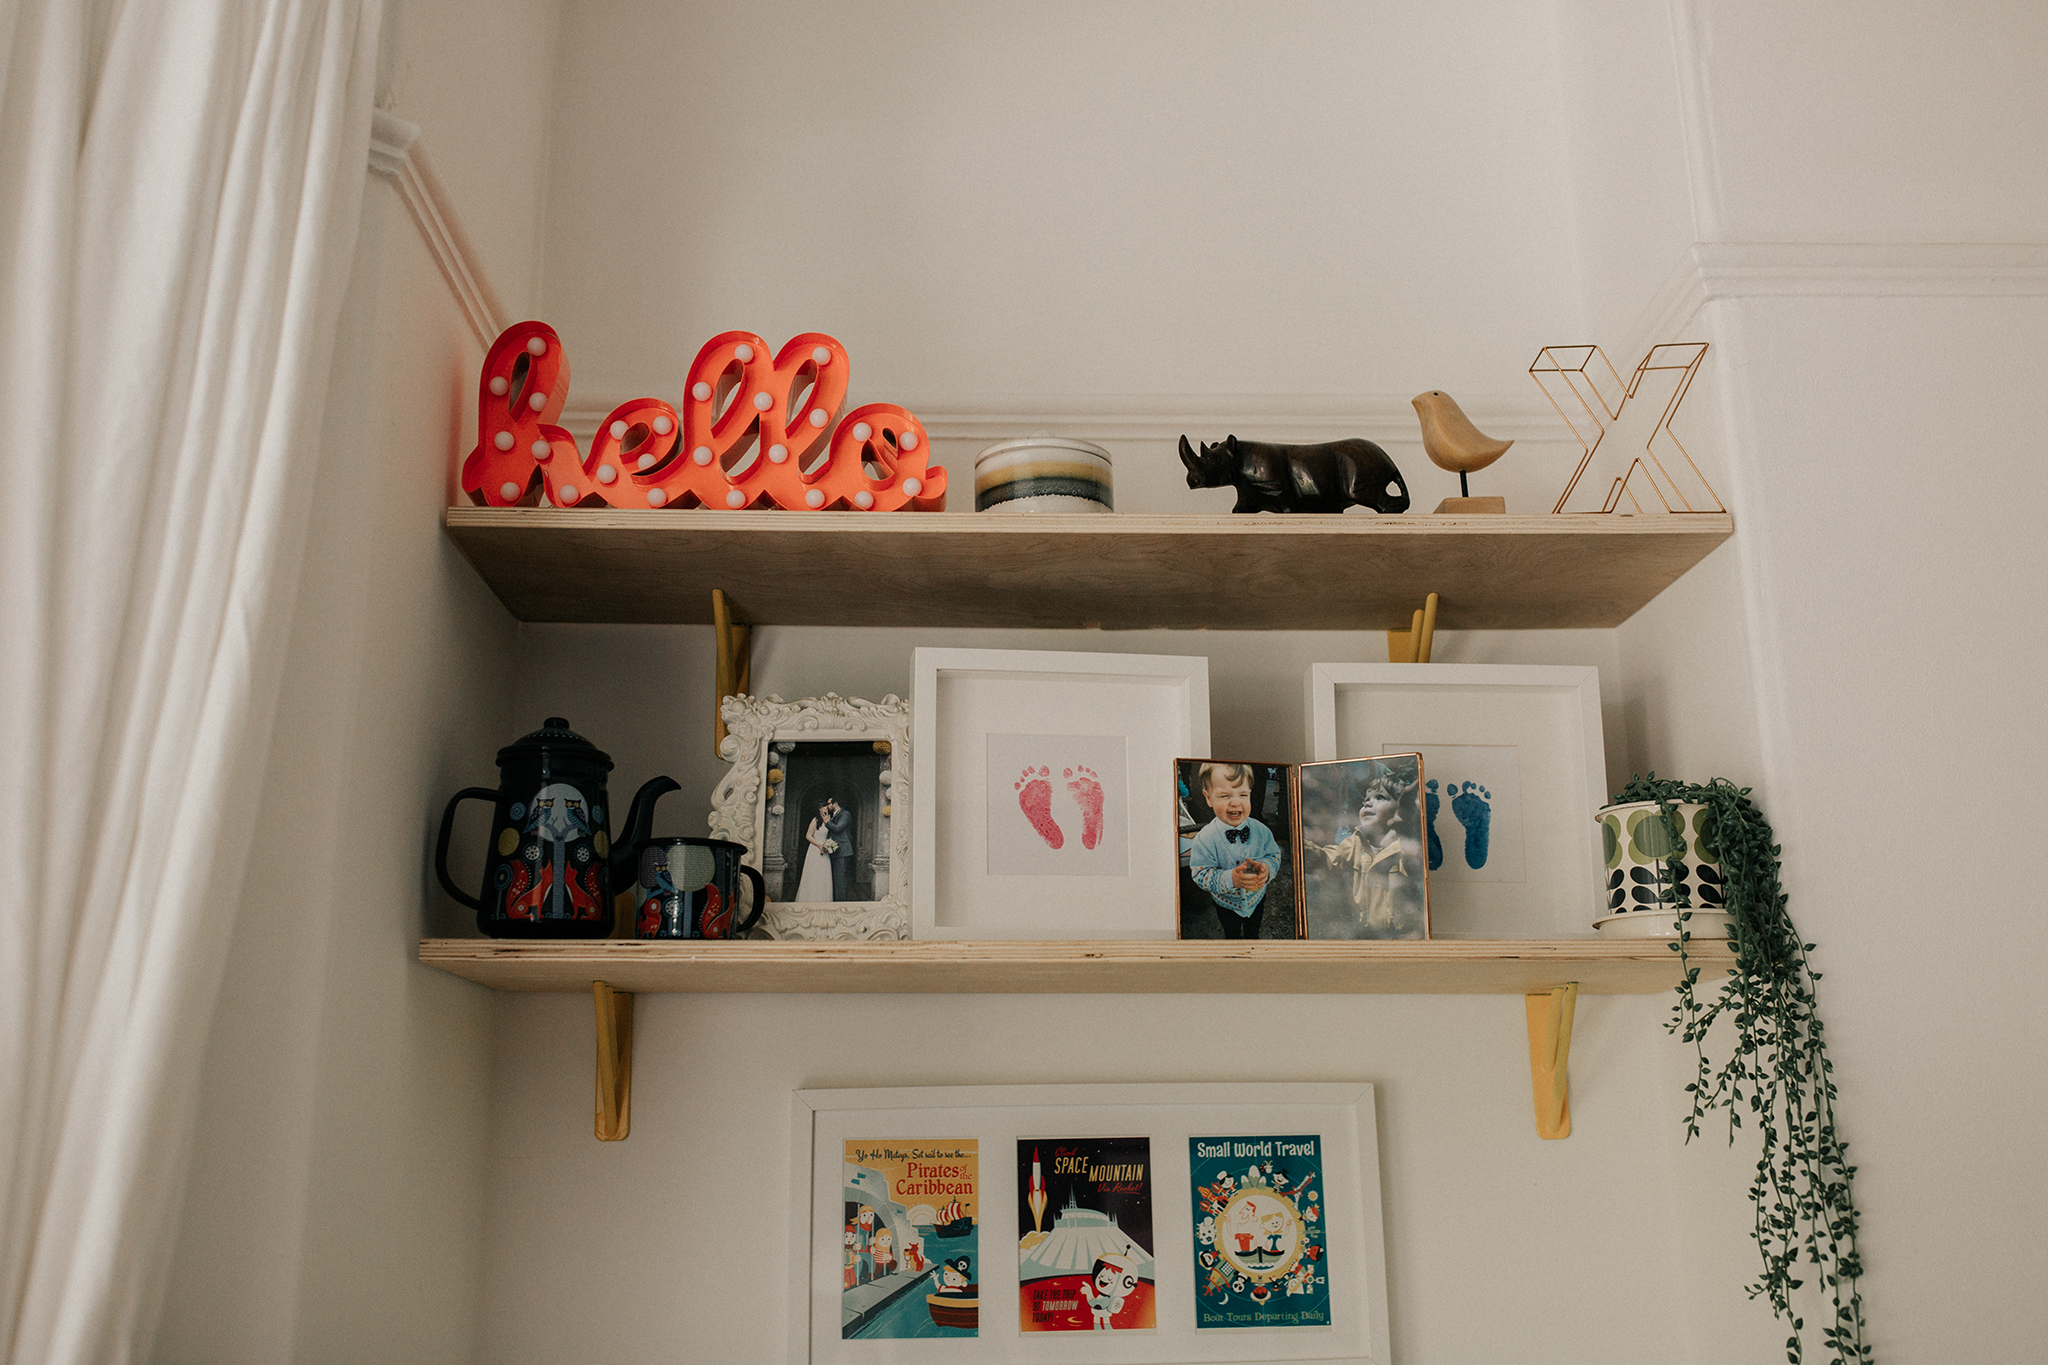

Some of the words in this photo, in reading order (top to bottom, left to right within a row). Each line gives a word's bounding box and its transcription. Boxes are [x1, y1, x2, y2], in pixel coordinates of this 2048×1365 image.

[462, 320, 948, 512] hello
[855, 1149, 868, 1163] Yo
[870, 1149, 882, 1161] Ho
[912, 1148, 924, 1159] Set
[925, 1149, 935, 1158] sail
[936, 1149, 943, 1158] to
[1054, 1146, 1078, 1157] Climb
[1197, 1141, 1231, 1158] Small
[1234, 1140, 1272, 1158] World
[1275, 1140, 1315, 1156] Travel
[906, 1162, 959, 1178] Pirates
[960, 1164, 968, 1173] of
[1054, 1156, 1089, 1174] SPACE
[1088, 1164, 1144, 1182] MOUNTAIN
[896, 1179, 973, 1195] Caribbean
[1097, 1183, 1110, 1193] Via
[1111, 1182, 1143, 1194] Rocket!
[1033, 1289, 1048, 1300] TAKE
[1050, 1289, 1061, 1300] THE
[1062, 1289, 1077, 1300] TRIP
[1032, 1301, 1041, 1312] OF
[1032, 1312, 1054, 1323] TODAY!
[1203, 1313, 1224, 1322] Boat
[1226, 1312, 1252, 1322] Tours
[1255, 1311, 1299, 1324] Departing
[1300, 1310, 1324, 1322] Daily
